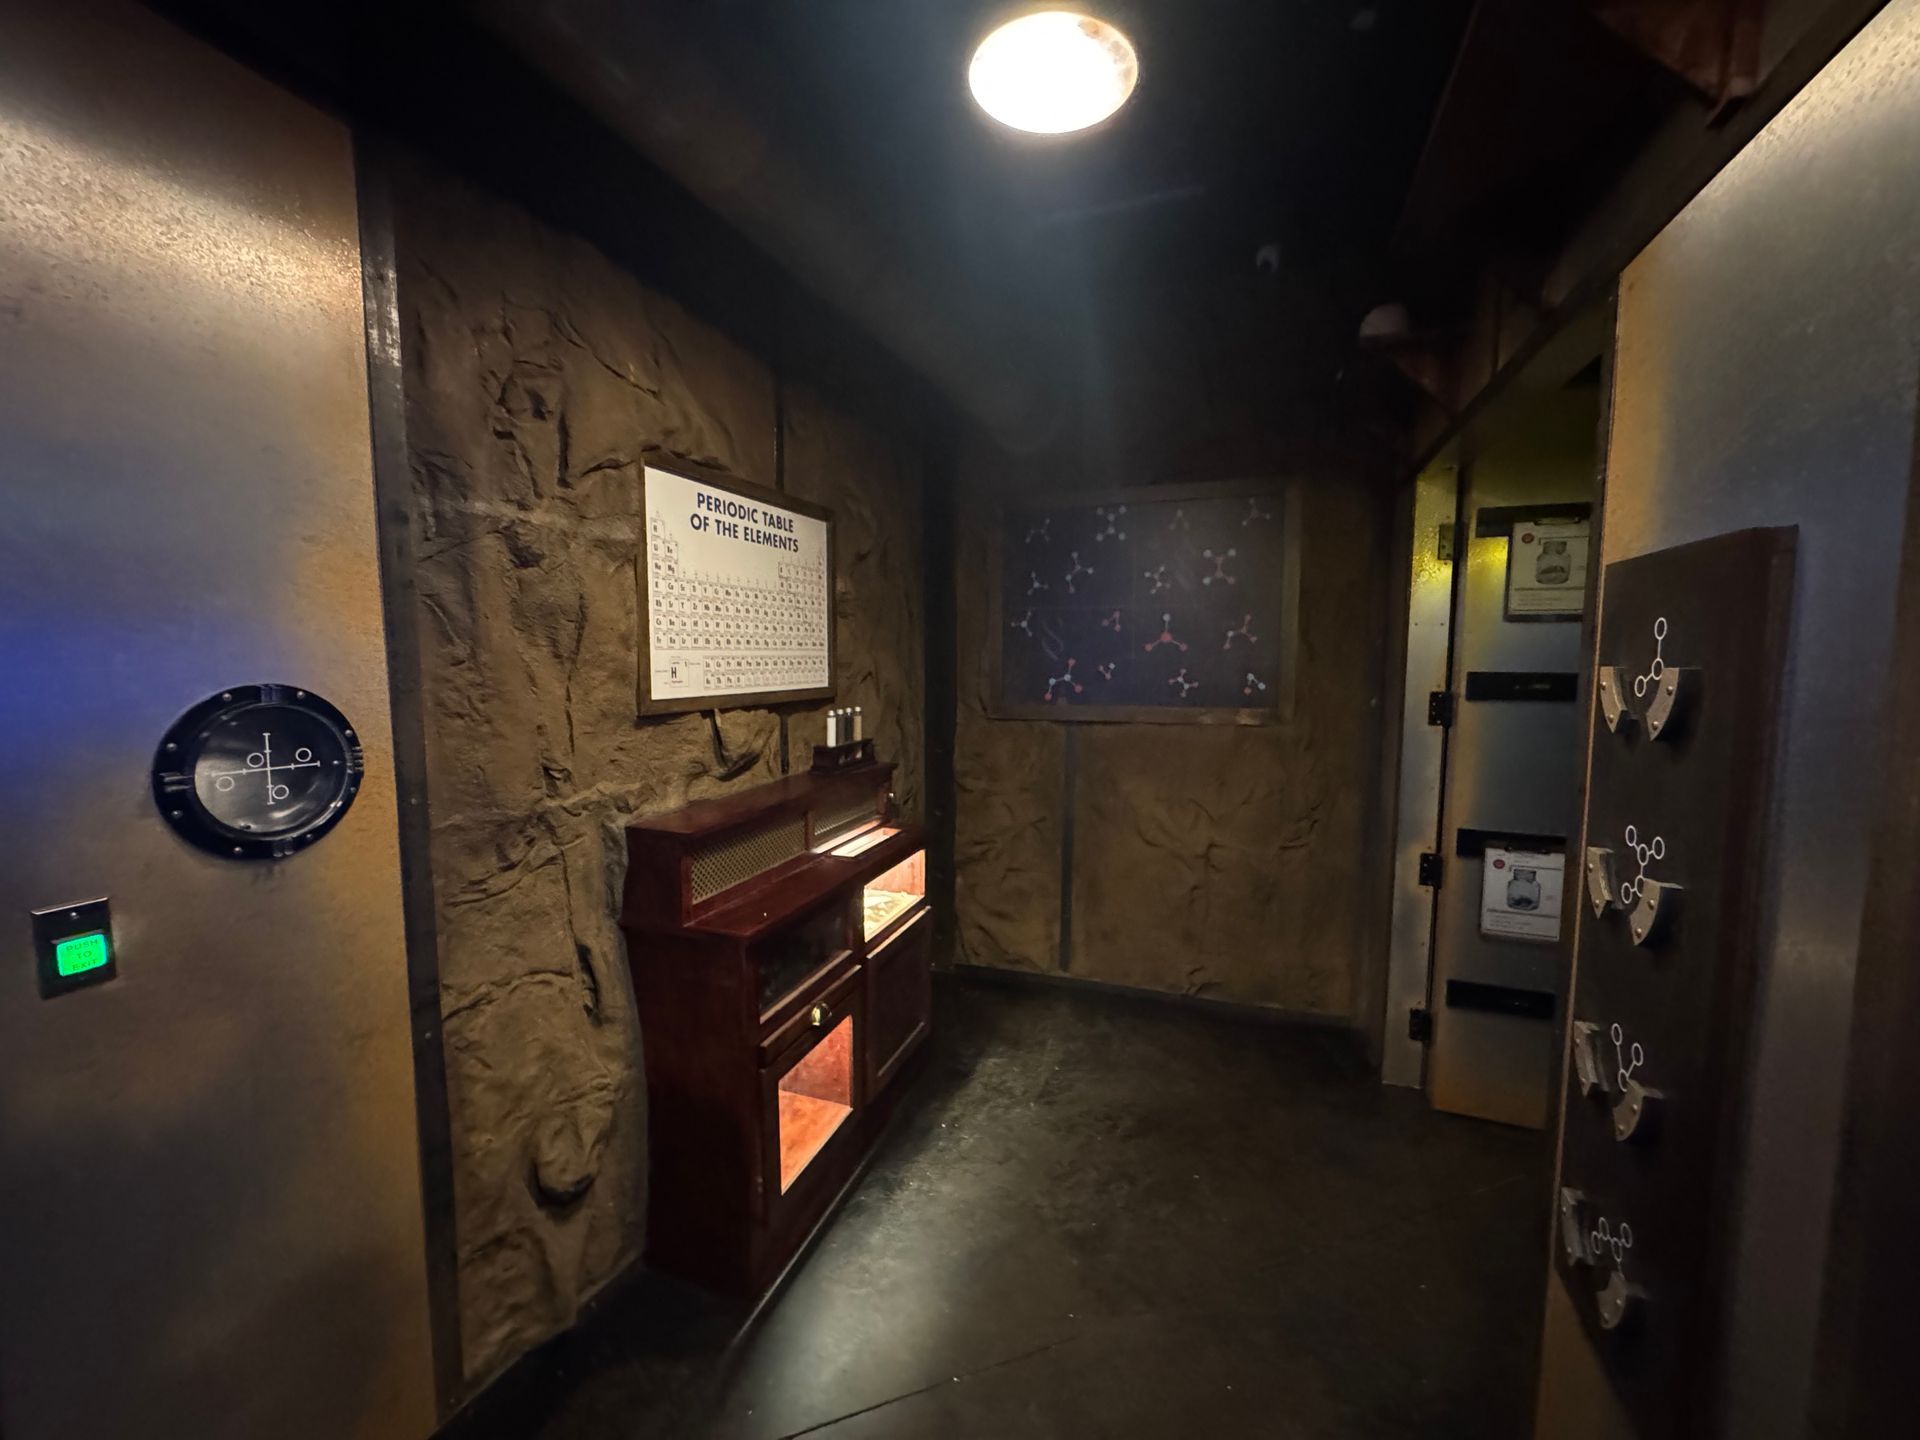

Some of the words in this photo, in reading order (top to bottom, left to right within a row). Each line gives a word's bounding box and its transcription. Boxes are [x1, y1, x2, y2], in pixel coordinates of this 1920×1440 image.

[697, 492, 758, 524] PERIODIC
[762, 511, 794, 533] TABLE
[690, 513, 710, 532] OF
[715, 519, 739, 539] THE
[743, 526, 799, 553] ELEMENTS
[66, 938, 98, 952] PUSH
[77, 950, 93, 959] TO
[72, 959, 97, 971] EXIT
